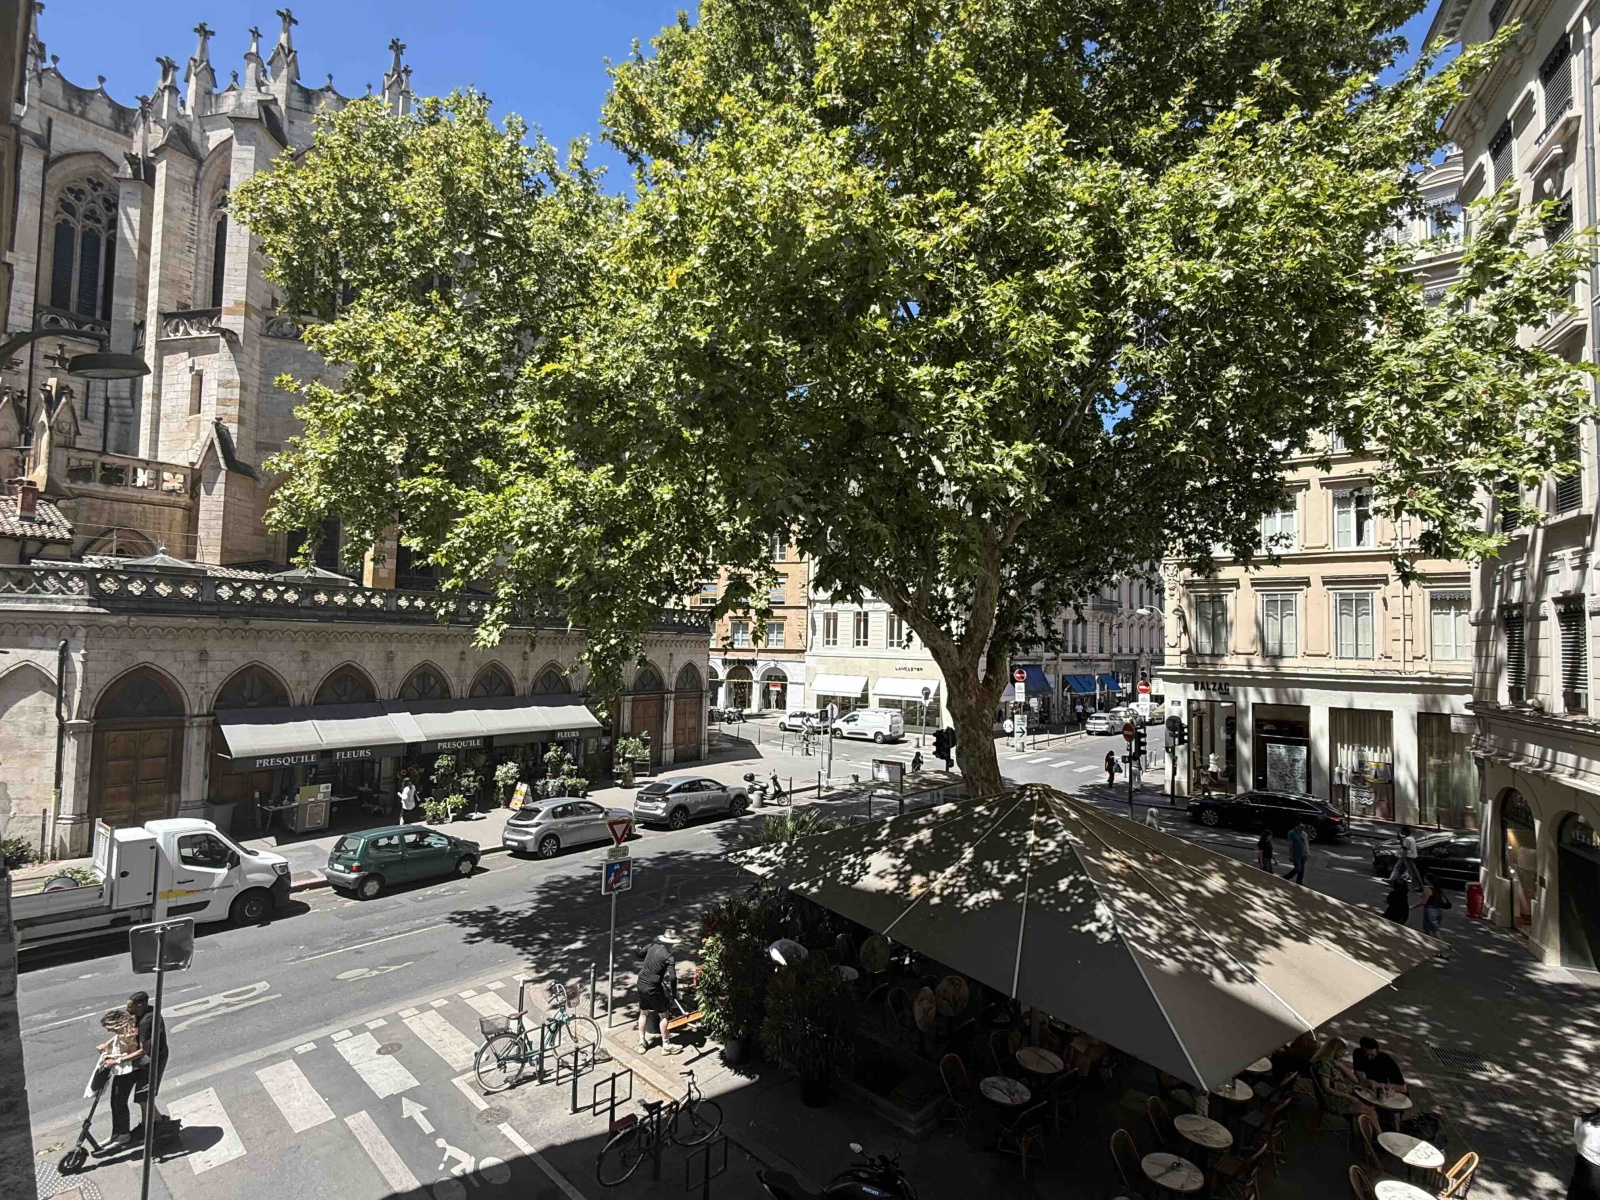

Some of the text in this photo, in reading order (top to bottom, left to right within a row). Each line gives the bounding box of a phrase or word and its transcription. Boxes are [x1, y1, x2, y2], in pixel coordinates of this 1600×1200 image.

[1193, 681, 1230, 692] BALZAC
[437, 739, 481, 750] PRESQU'ILE
[255, 749, 372, 768] PRESQU'ILE FLEURS
[862, 1186, 879, 1196] DUCATI
